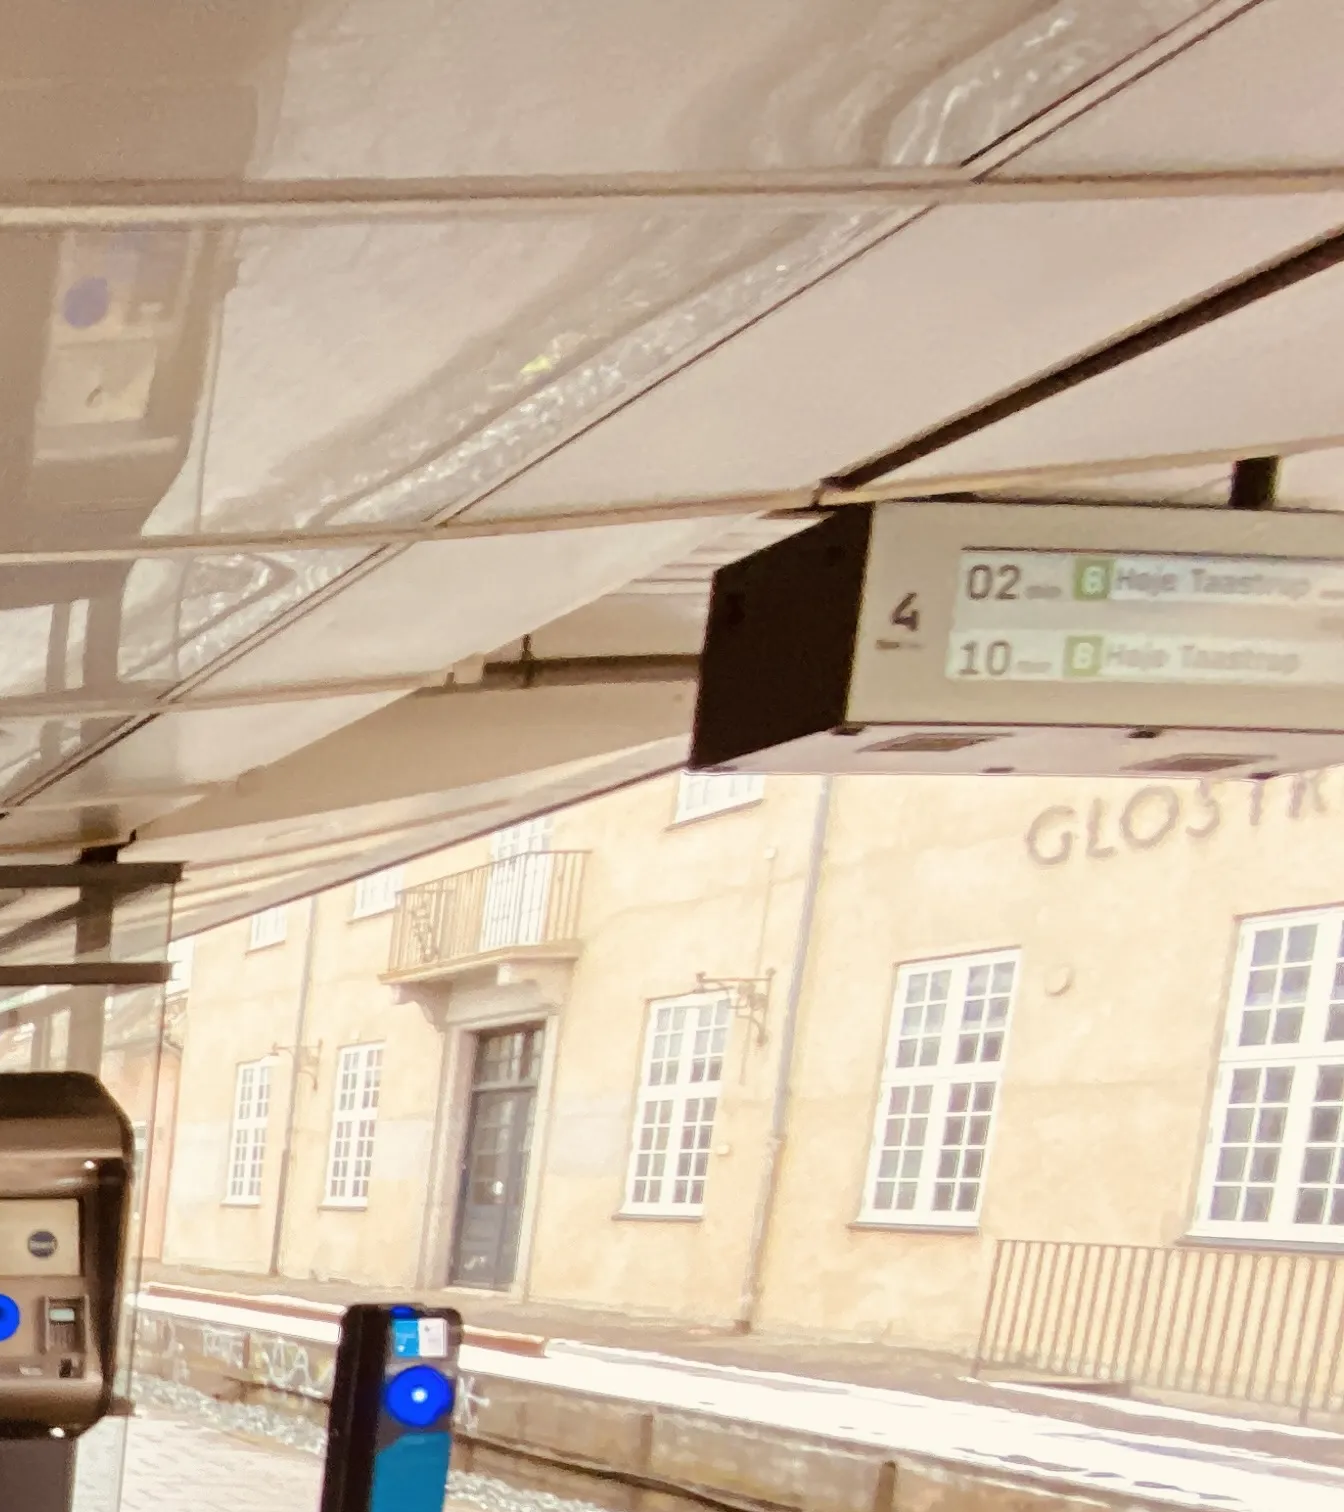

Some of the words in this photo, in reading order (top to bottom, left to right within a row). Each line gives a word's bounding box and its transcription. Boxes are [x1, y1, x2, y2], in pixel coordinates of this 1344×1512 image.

[967, 563, 1022, 601] 02
[890, 591, 921, 632] 4
[959, 640, 1012, 677] 10
